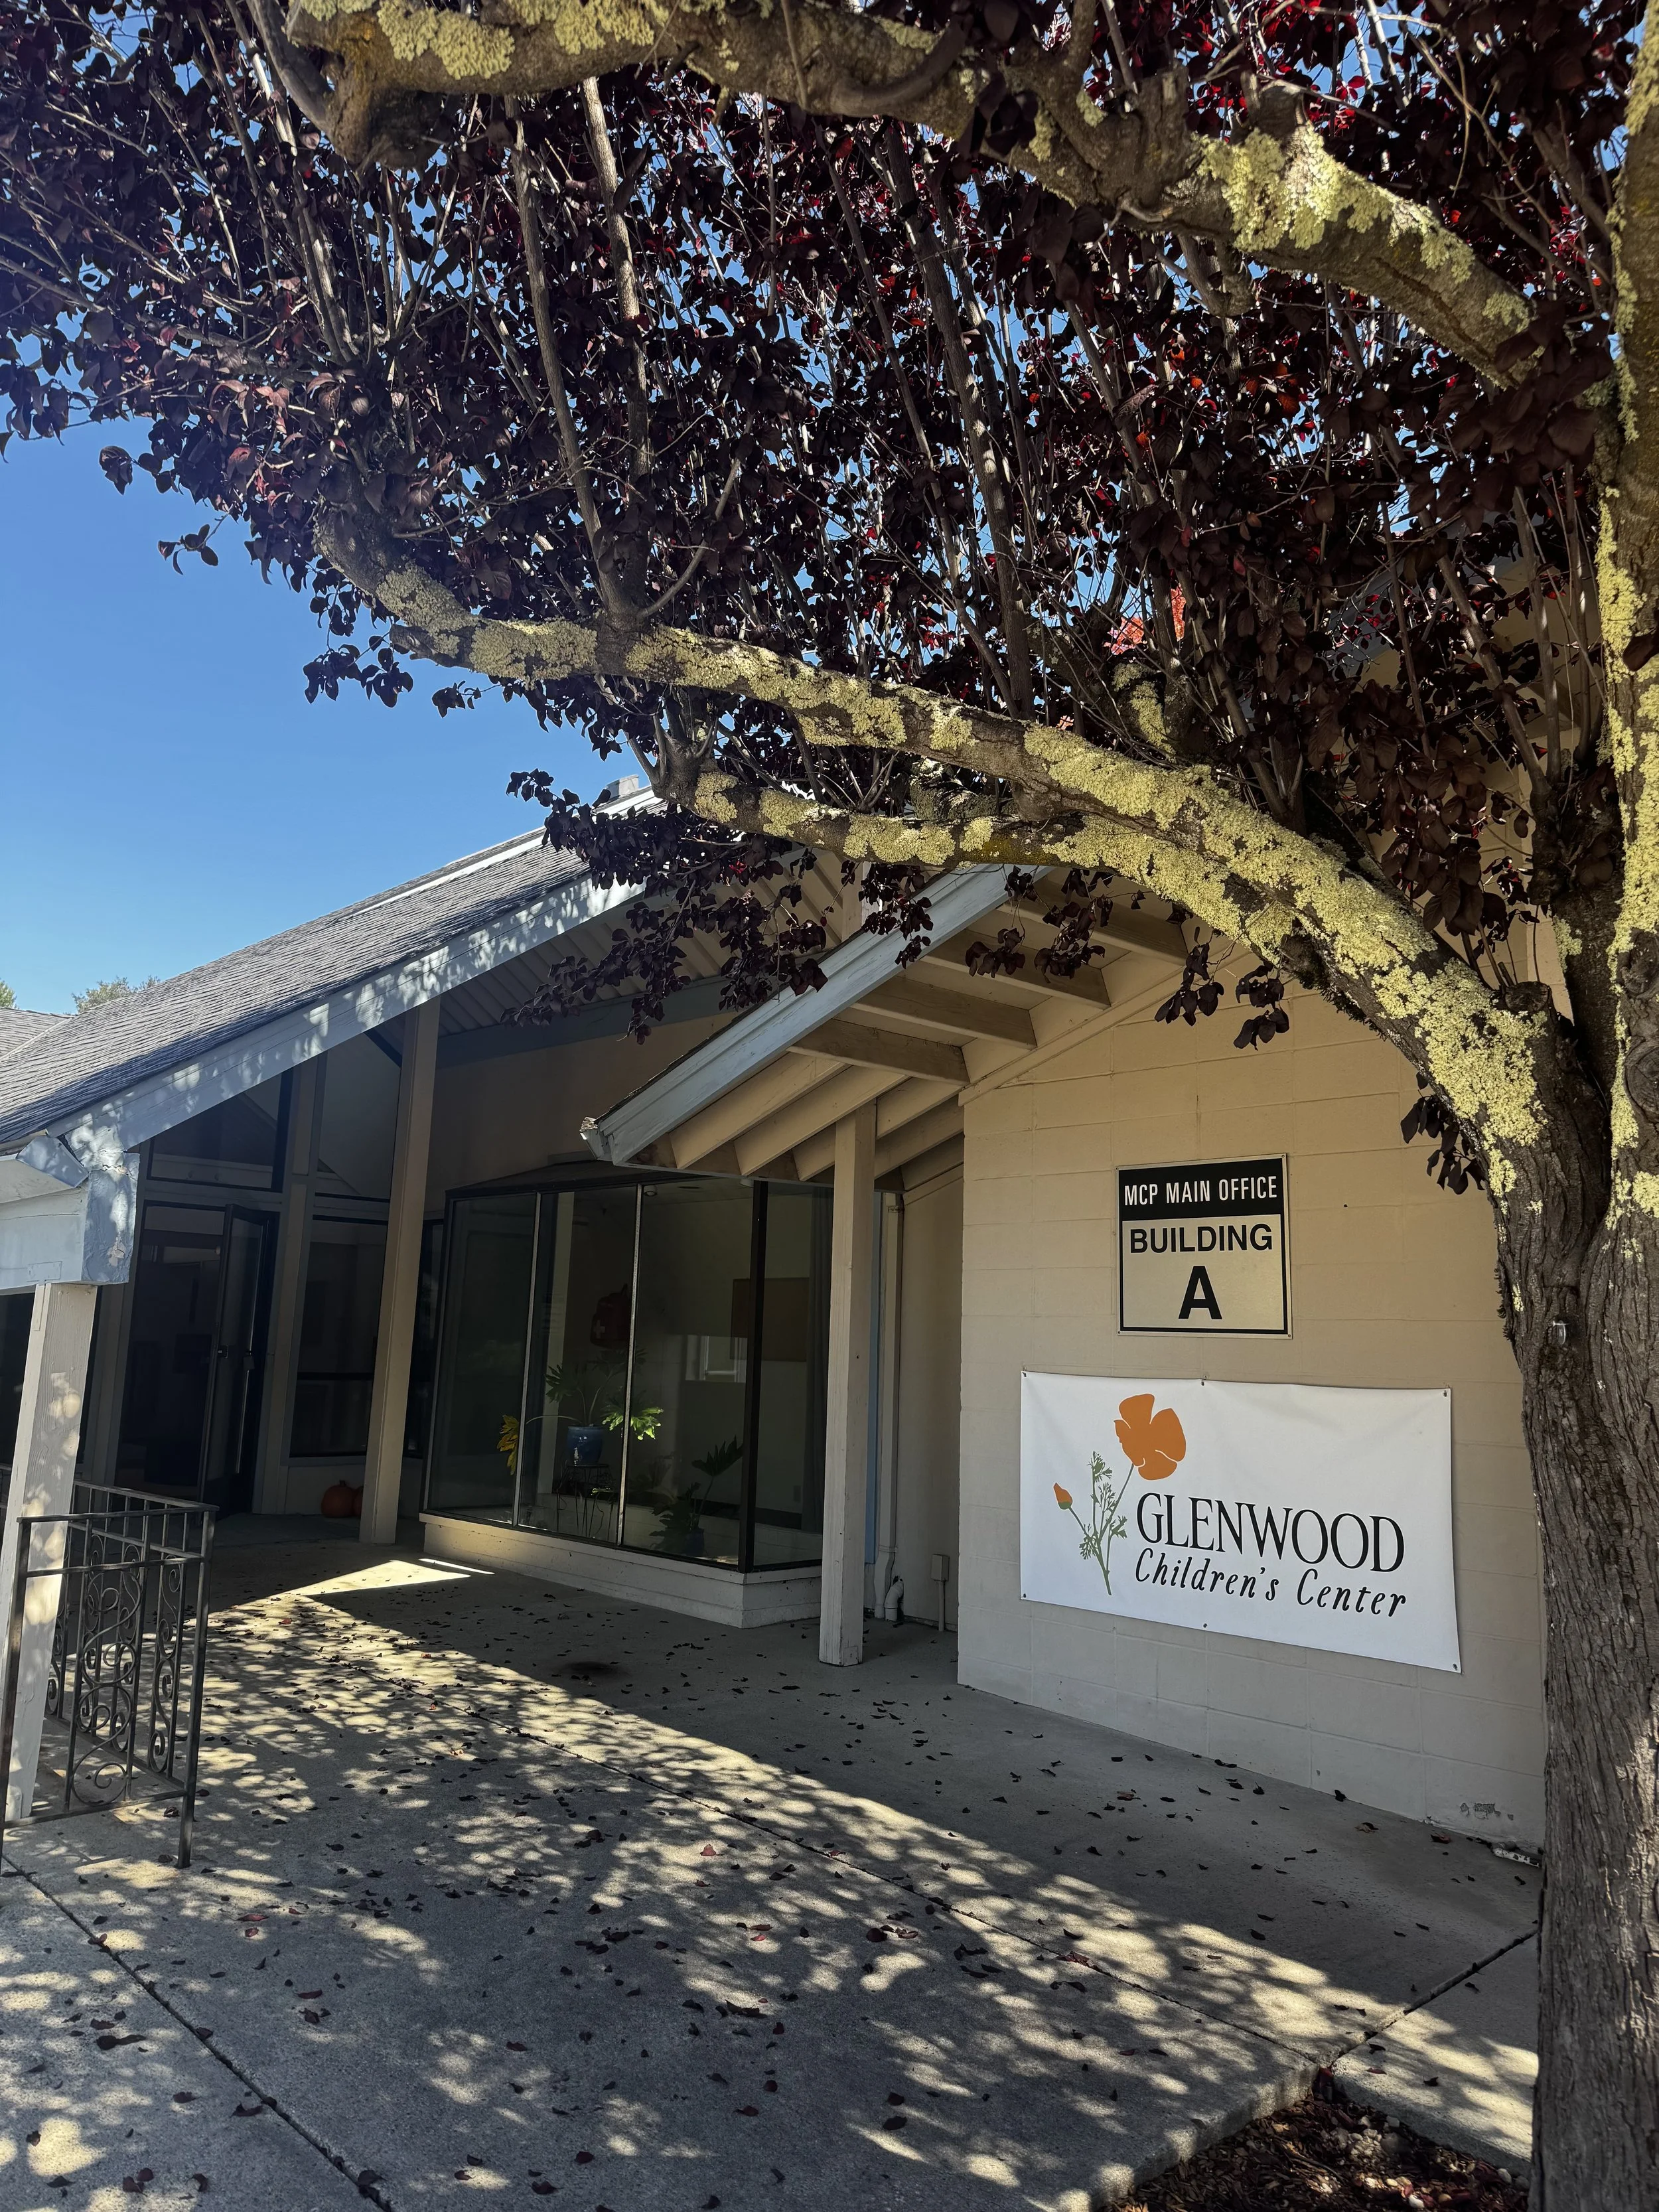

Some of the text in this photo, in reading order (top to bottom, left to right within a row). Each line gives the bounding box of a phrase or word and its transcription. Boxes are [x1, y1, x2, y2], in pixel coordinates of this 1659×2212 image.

[1124, 1176, 1277, 1206] MCP MAIN OFFICE
[1130, 1223, 1273, 1254] BUILDING
[1178, 1266, 1223, 1320] A
[1136, 1493, 1406, 1573] GLENWOOD
[1135, 1547, 1407, 1617] Children's Center
